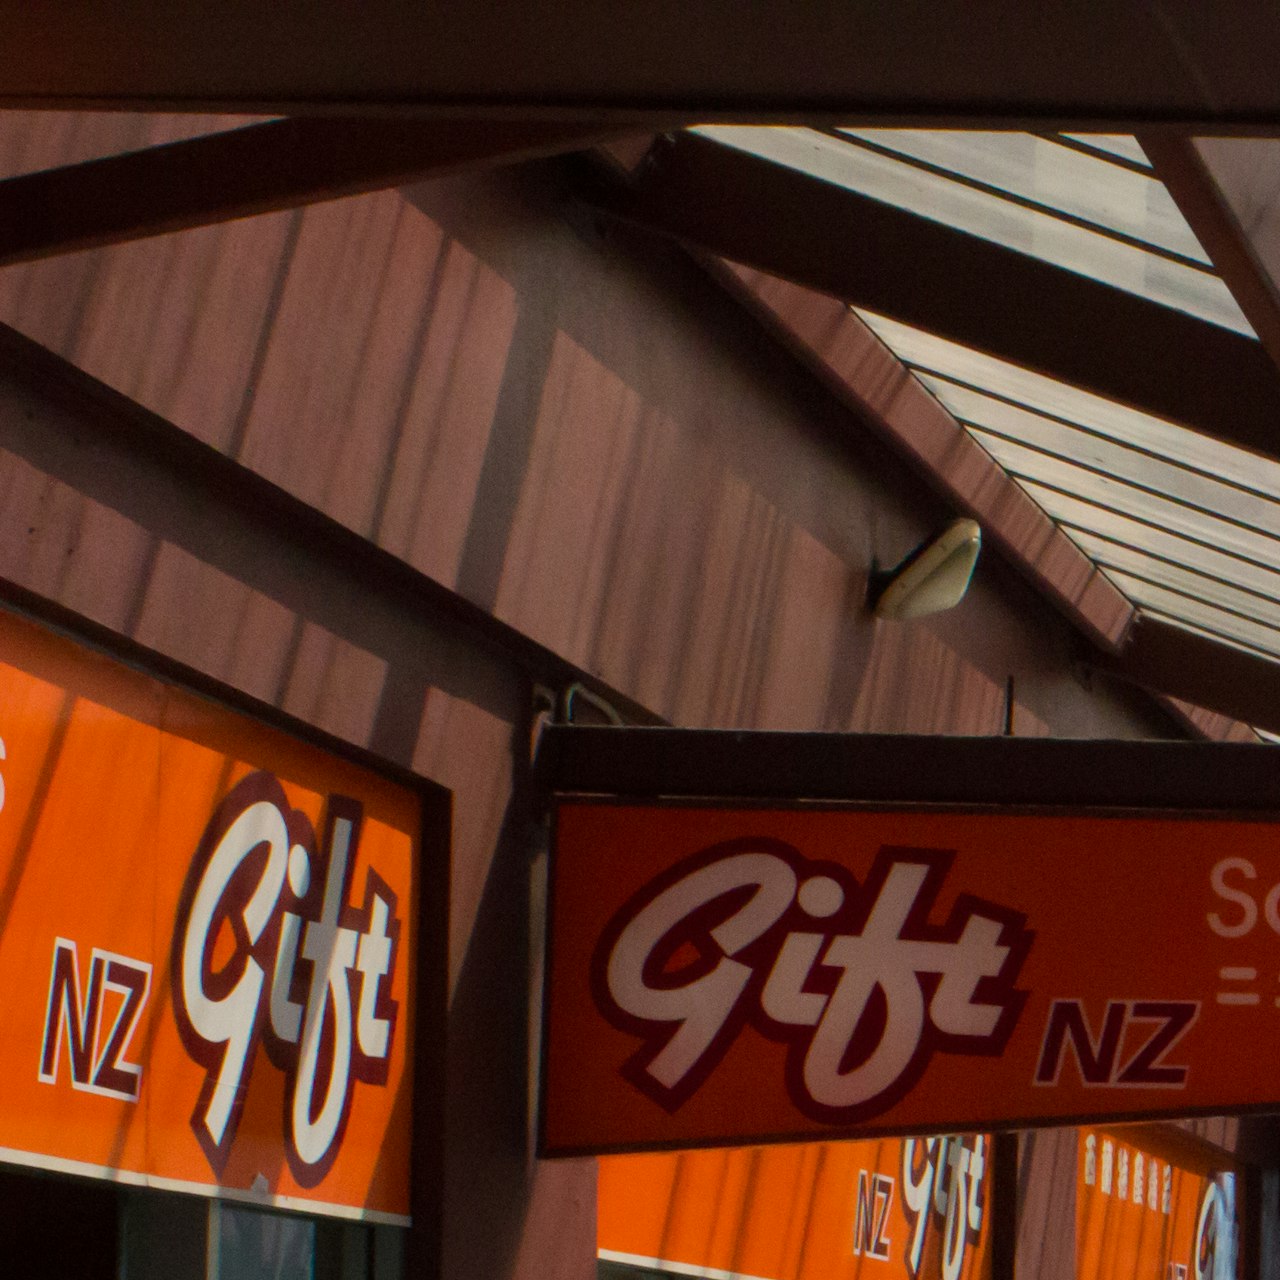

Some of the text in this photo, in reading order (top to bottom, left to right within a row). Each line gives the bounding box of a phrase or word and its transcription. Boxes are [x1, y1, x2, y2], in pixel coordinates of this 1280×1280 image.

[39, 788, 397, 1176] NZ Gift
[600, 845, 1201, 1116] Gift NZ
[853, 1169, 894, 1262] NZ
